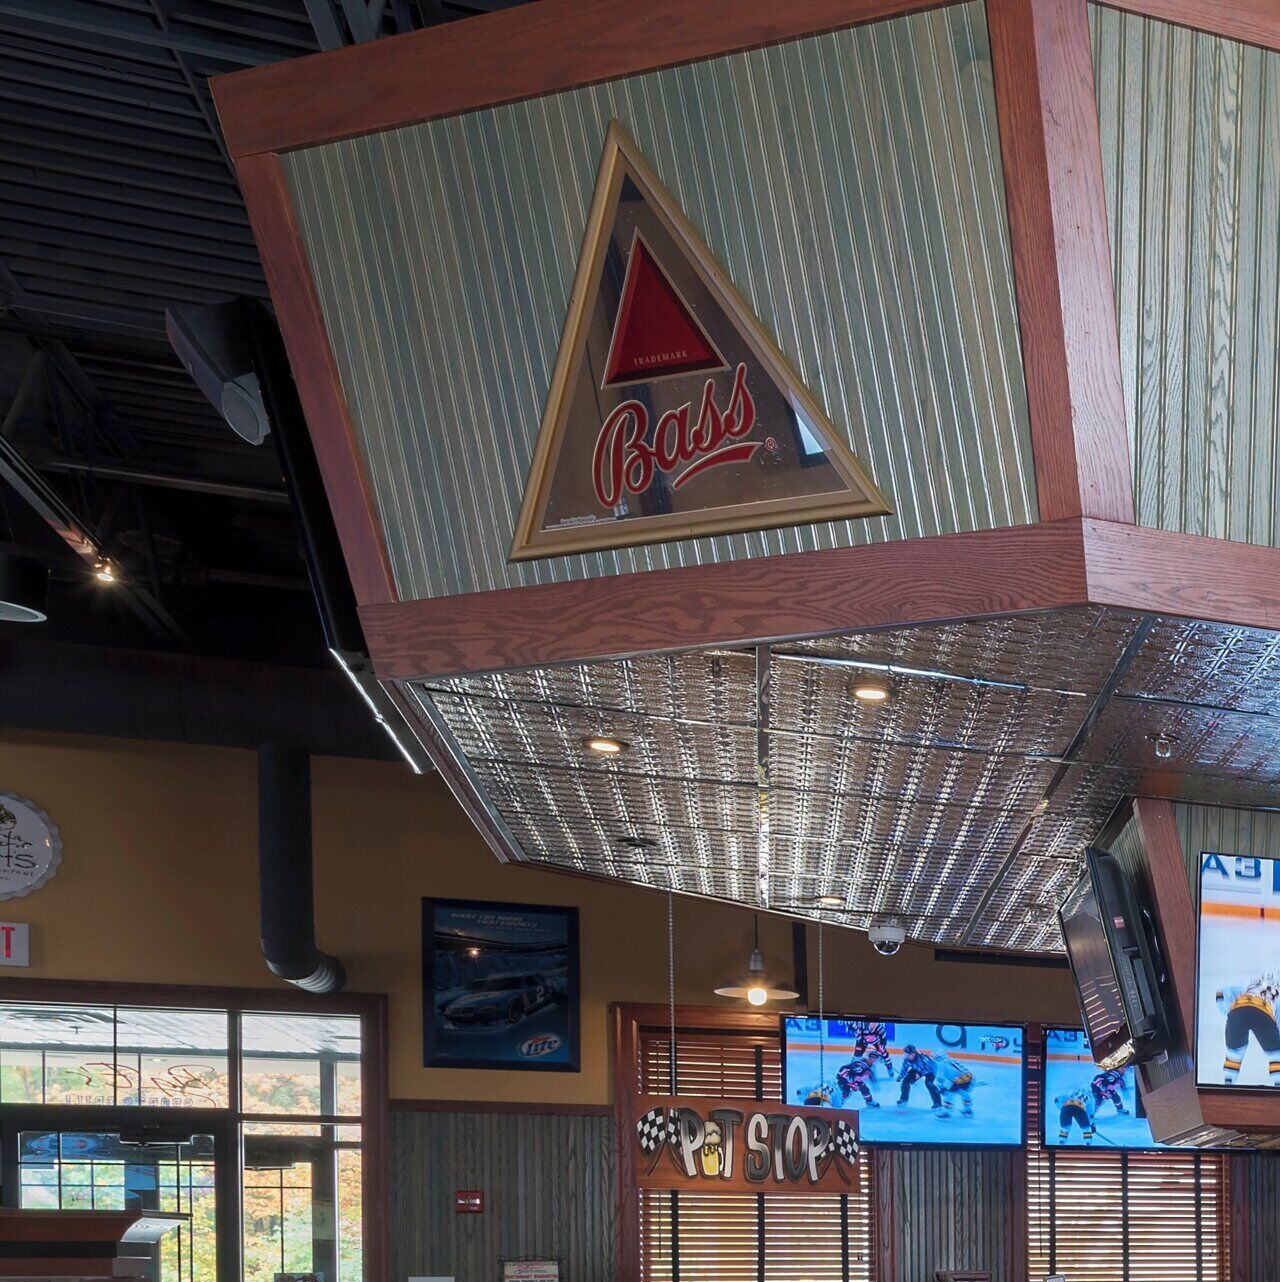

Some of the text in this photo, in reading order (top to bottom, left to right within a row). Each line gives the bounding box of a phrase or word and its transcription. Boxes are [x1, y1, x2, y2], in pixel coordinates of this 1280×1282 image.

[633, 350, 688, 366] TRADEMARK
[592, 362, 756, 509] Bass
[745, 1112, 830, 1183] STOP
